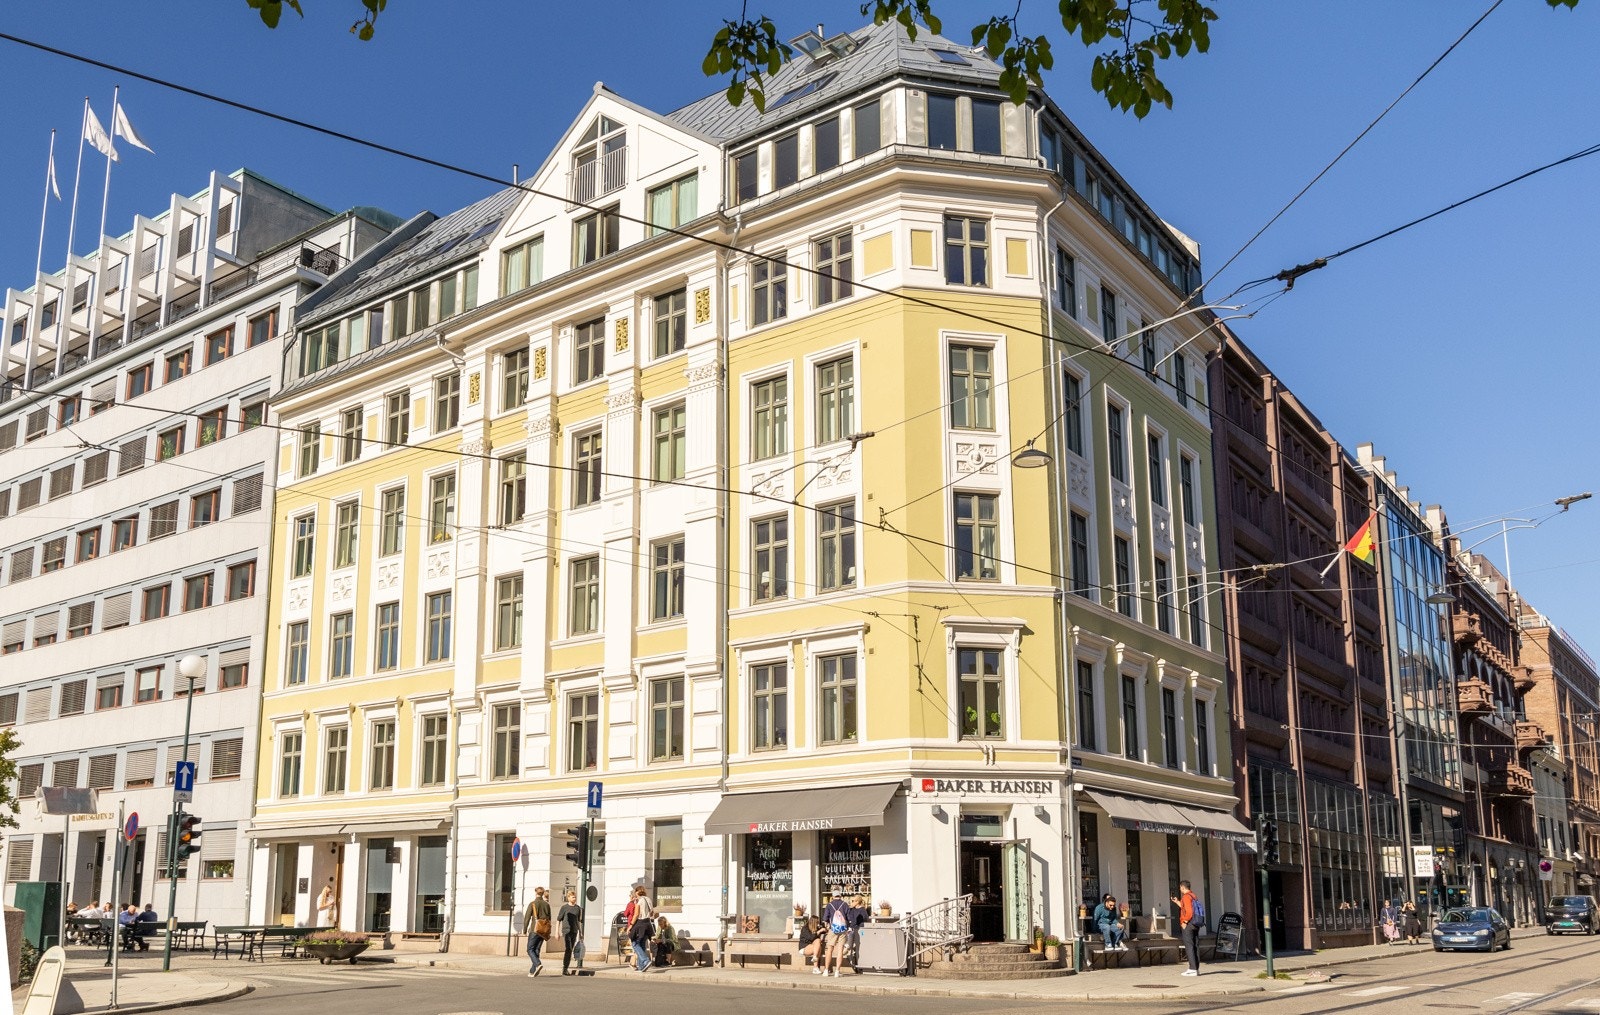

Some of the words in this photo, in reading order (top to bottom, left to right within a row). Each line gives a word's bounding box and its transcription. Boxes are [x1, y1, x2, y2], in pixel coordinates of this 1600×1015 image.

[936, 779, 985, 793] BAKER
[990, 780, 1053, 794] HANSEN
[757, 822, 788, 832] BAKER
[791, 819, 834, 831] HANSEN
